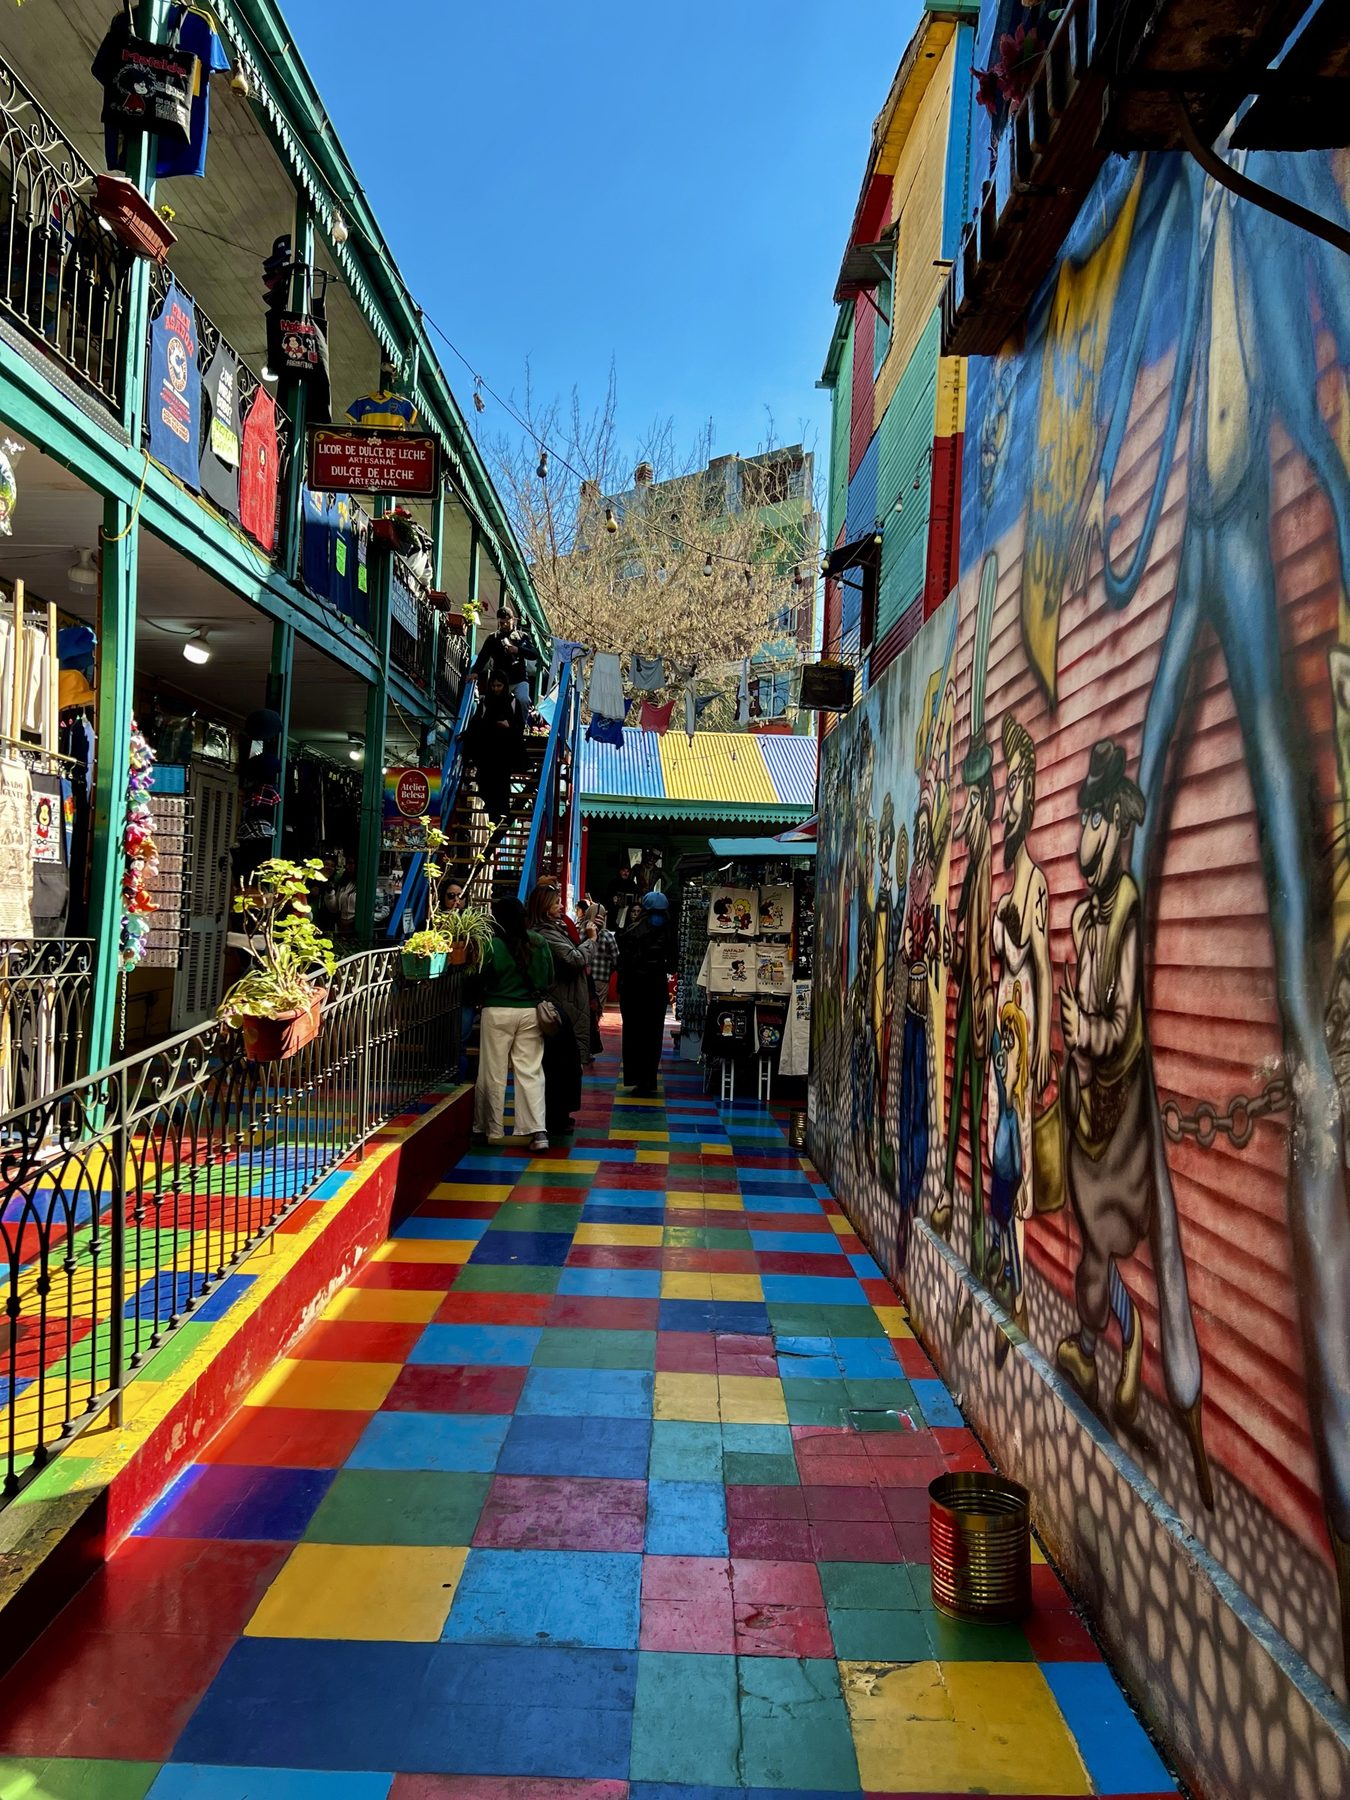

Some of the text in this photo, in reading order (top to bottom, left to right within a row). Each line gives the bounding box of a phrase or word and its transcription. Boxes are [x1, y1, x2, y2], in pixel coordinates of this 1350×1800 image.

[122, 48, 186, 76] Mafalda
[318, 443, 426, 460] LICOR DE DULCE DE LECHE
[348, 456, 397, 466] ARTESANAL
[331, 466, 415, 480] DULCE DE LECHE
[348, 477, 398, 487] ARTESANAL
[401, 783, 426, 791] Atelier
[401, 791, 425, 799] Belesa
